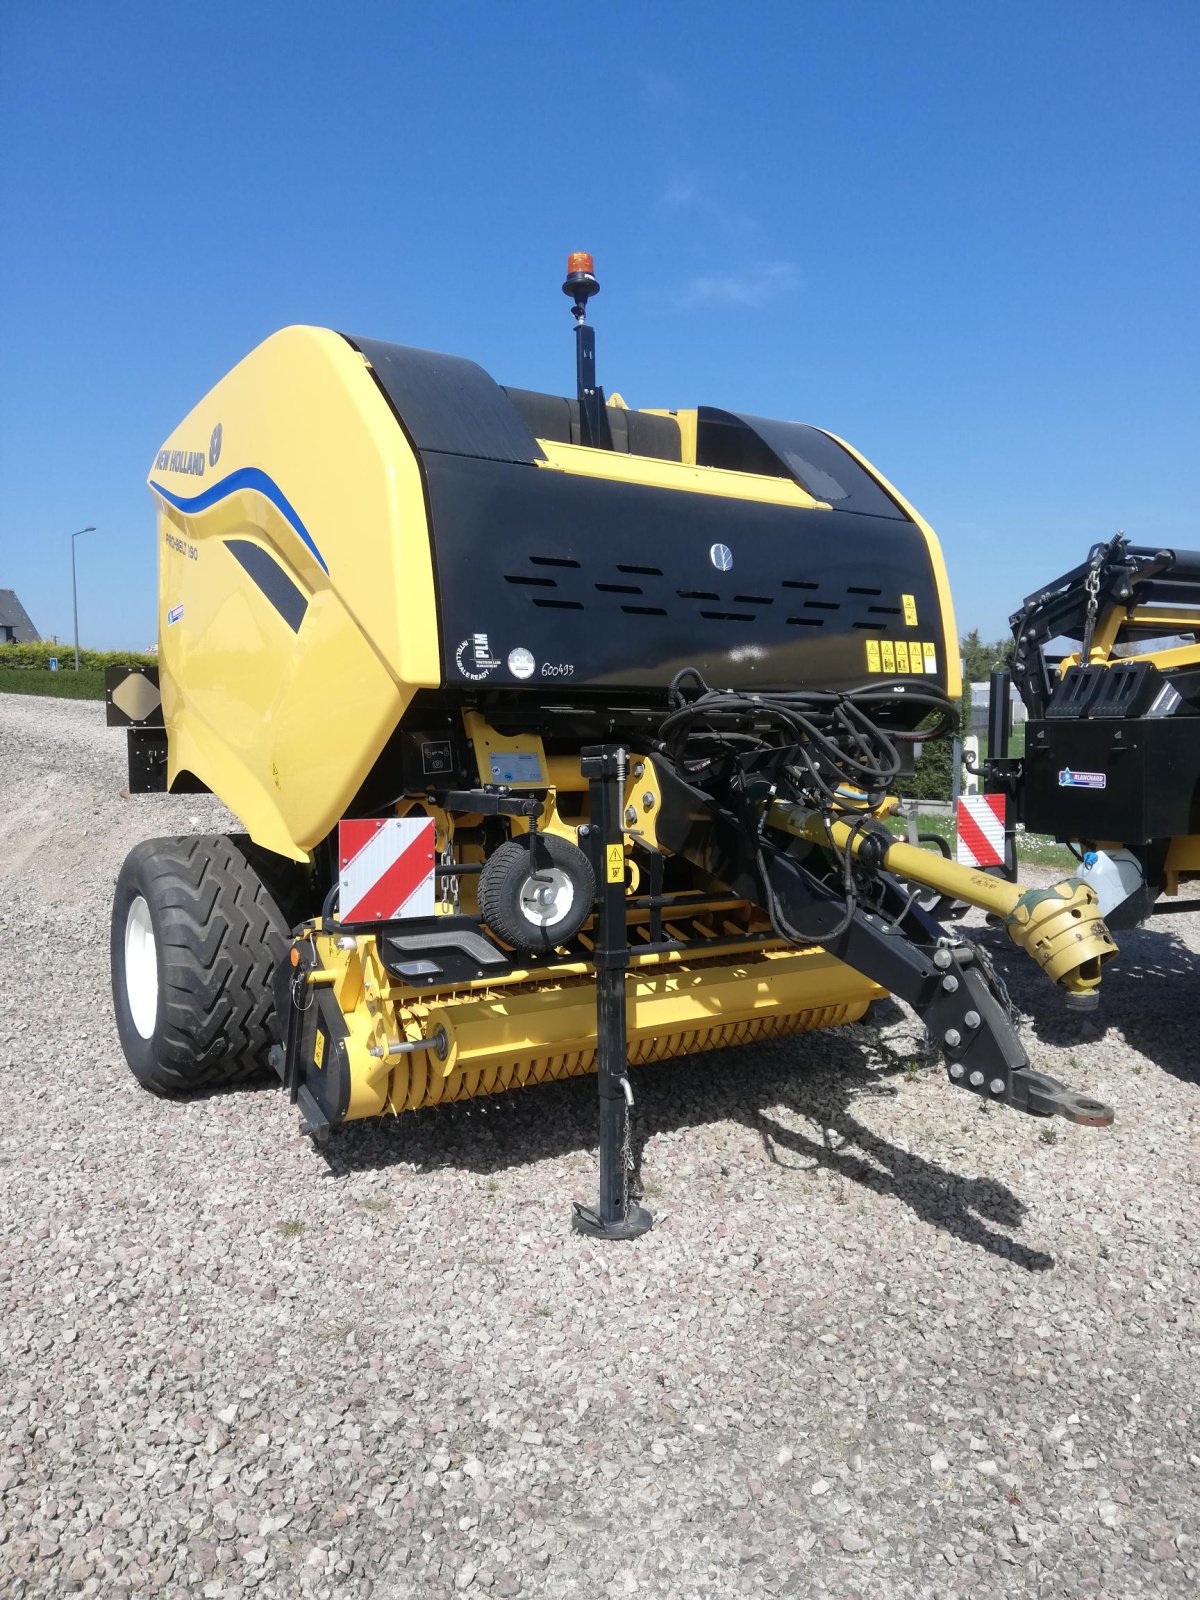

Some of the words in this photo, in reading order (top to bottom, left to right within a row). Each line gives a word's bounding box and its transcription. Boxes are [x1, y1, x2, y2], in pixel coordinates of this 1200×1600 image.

[155, 449, 171, 471] NEW
[169, 450, 205, 477] HOLLAND
[475, 634, 489, 658] PLM
[514, 656, 528, 664] OK
[470, 669, 490, 681] READY
[541, 662, 574, 677] 600493
